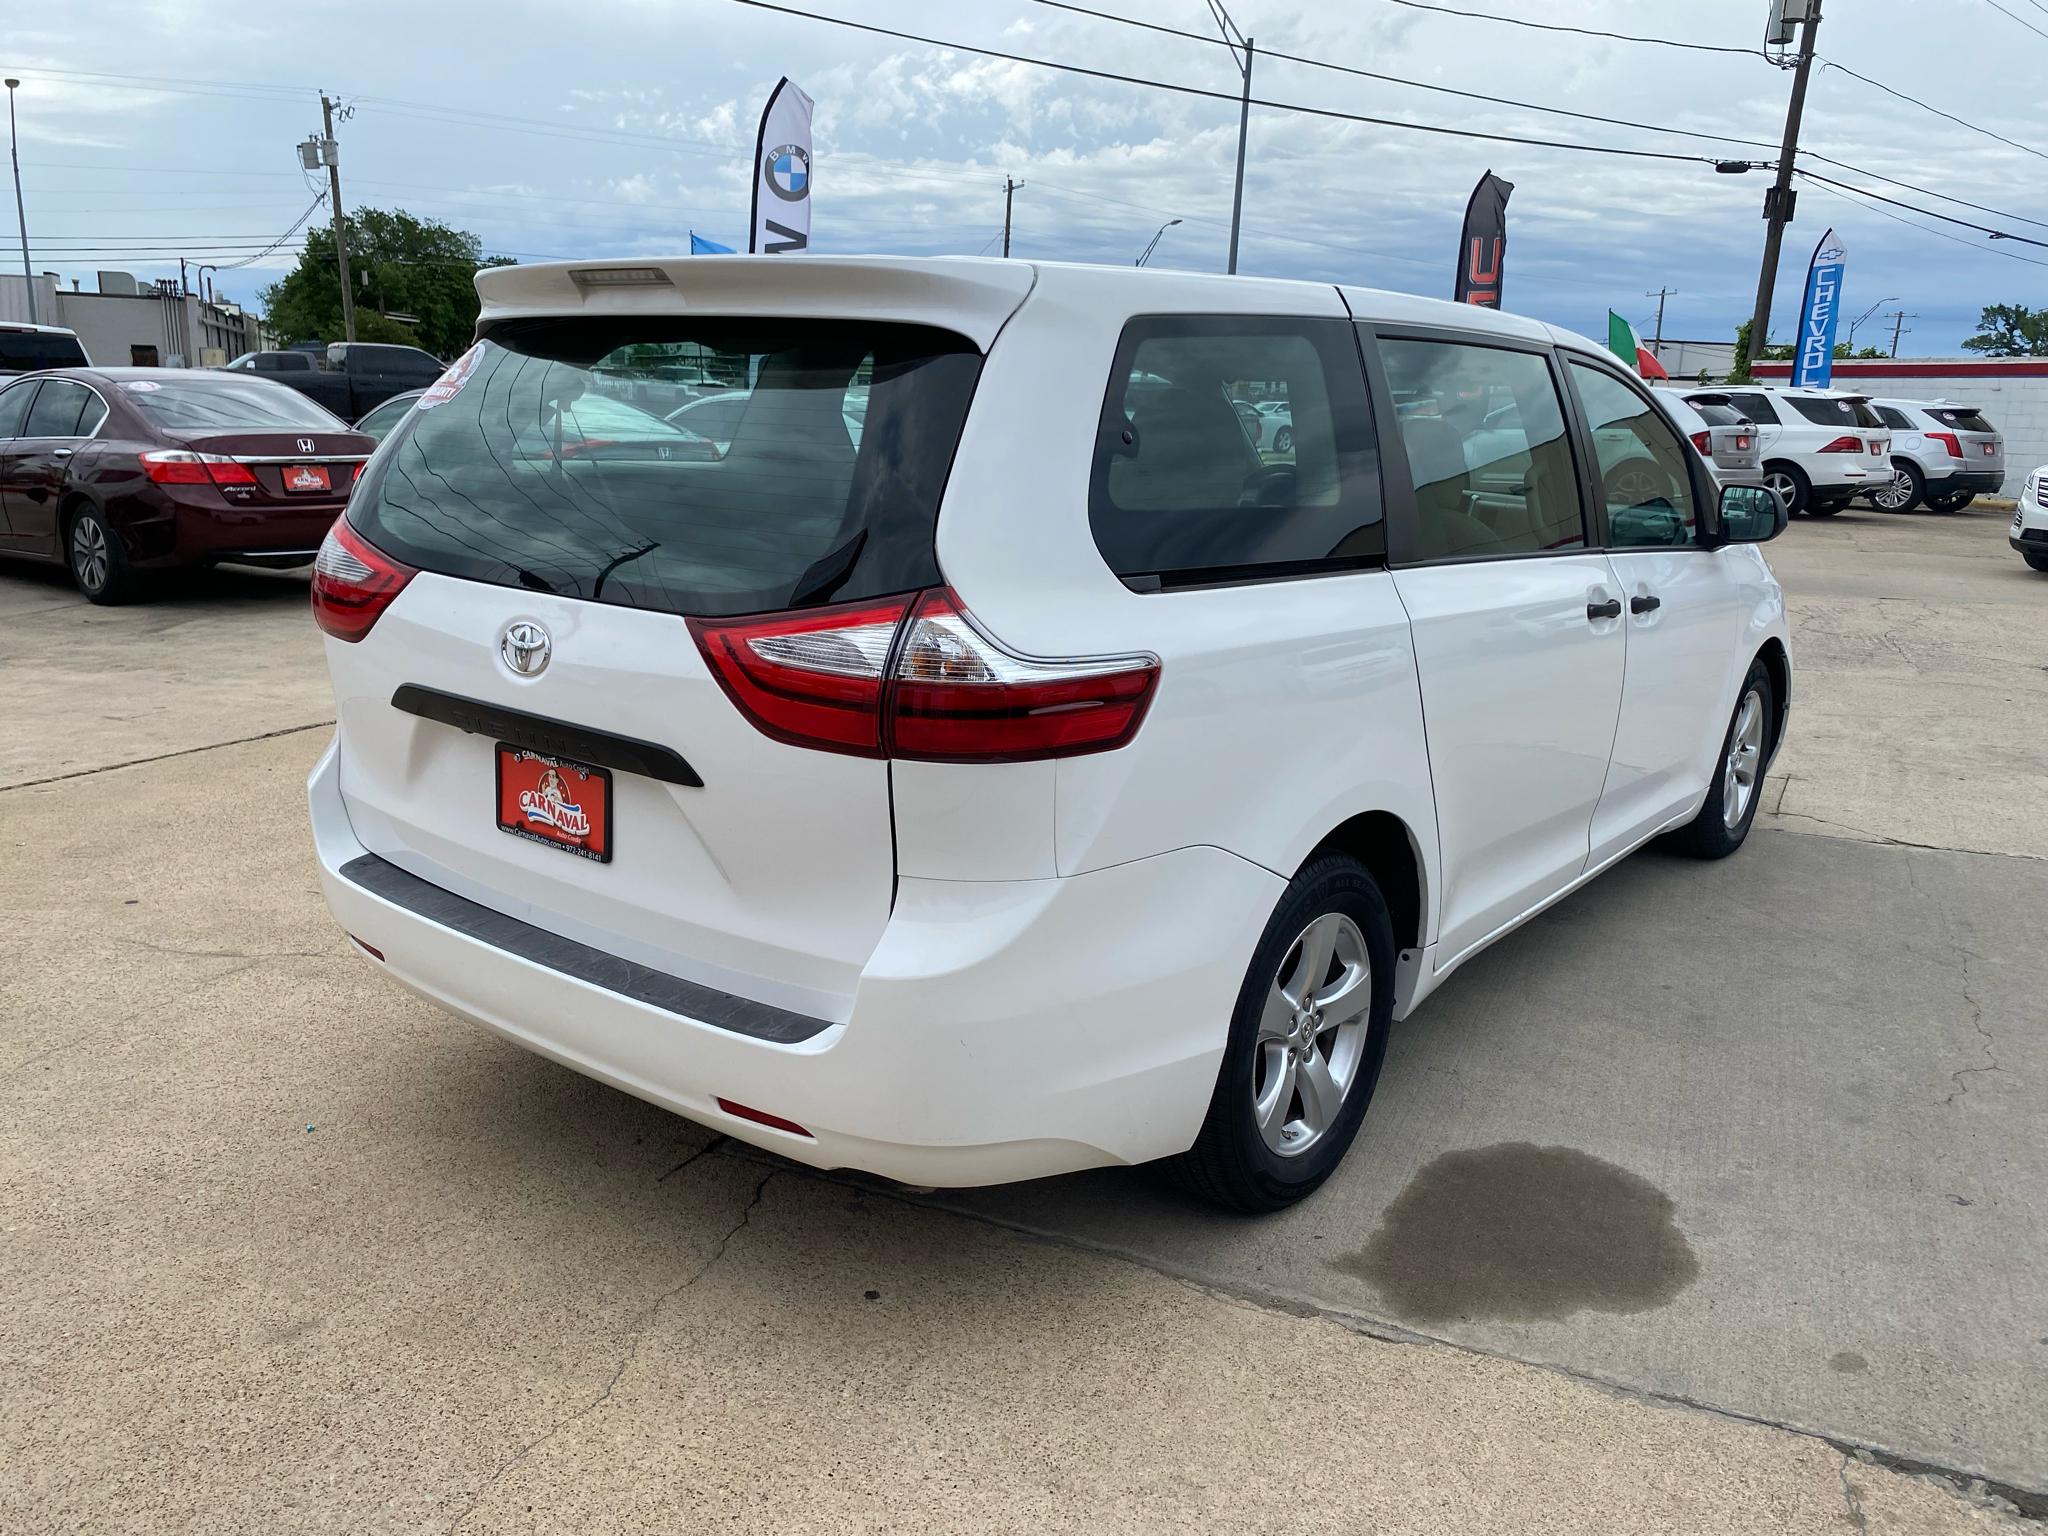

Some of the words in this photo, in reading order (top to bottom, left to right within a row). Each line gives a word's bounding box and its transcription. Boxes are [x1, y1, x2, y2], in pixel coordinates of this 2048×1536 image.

[770, 145, 808, 163] BMW
[1800, 267, 1836, 388] CHEVROL
[521, 750, 559, 768] CARNAVAL
[559, 760, 573, 770] Auto
[572, 763, 590, 775] Credit
[519, 790, 589, 833] CARNAVAL
[556, 830, 568, 839] Auto
